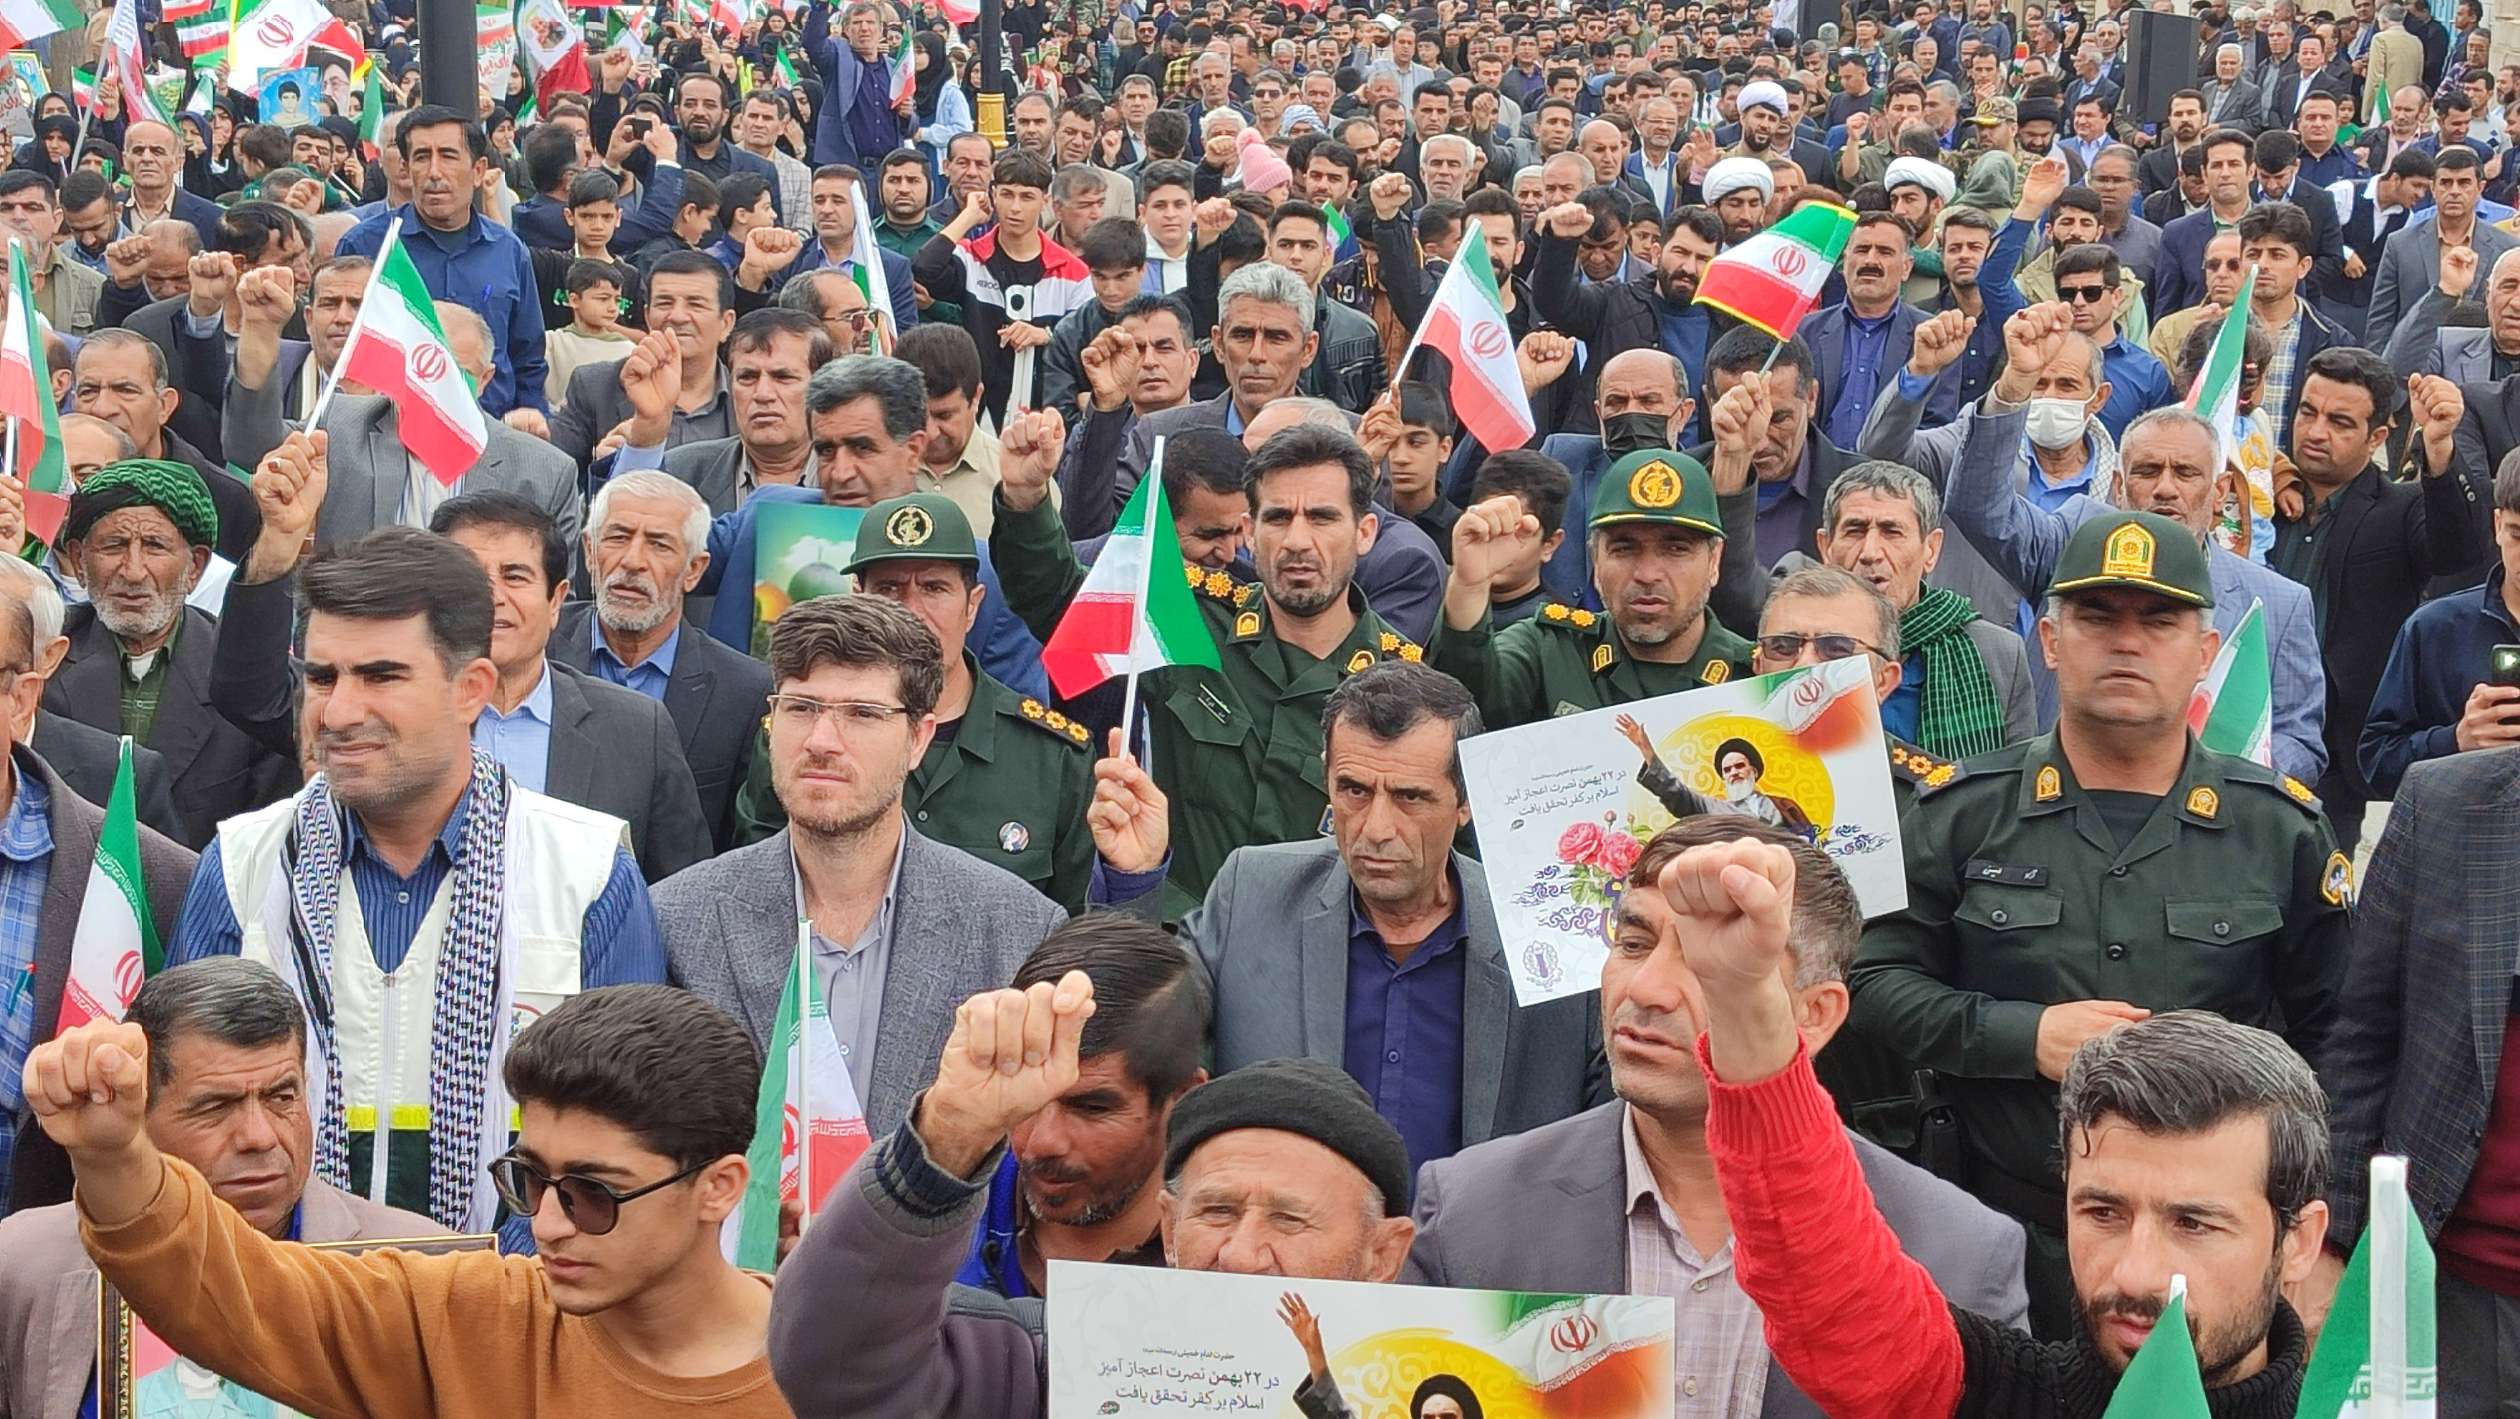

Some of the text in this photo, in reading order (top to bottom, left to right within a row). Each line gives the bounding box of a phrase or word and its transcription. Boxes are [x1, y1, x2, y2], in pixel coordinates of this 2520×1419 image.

[1550, 778, 1577, 794] نصرت
[1578, 776, 1602, 789] بهمن
[1523, 783, 1549, 801] اعجاز
[1569, 790, 1585, 808] کفر
[1595, 785, 1619, 802] اسلام
[1519, 802, 1542, 816] یافت
[1542, 797, 1568, 813] تحقق
[1098, 1358, 1280, 1390] در ۲۲ بهمن نصرت اعجاز آمیز
[1116, 1384, 1264, 1414] اسلام بر کفر تحقق یافت
